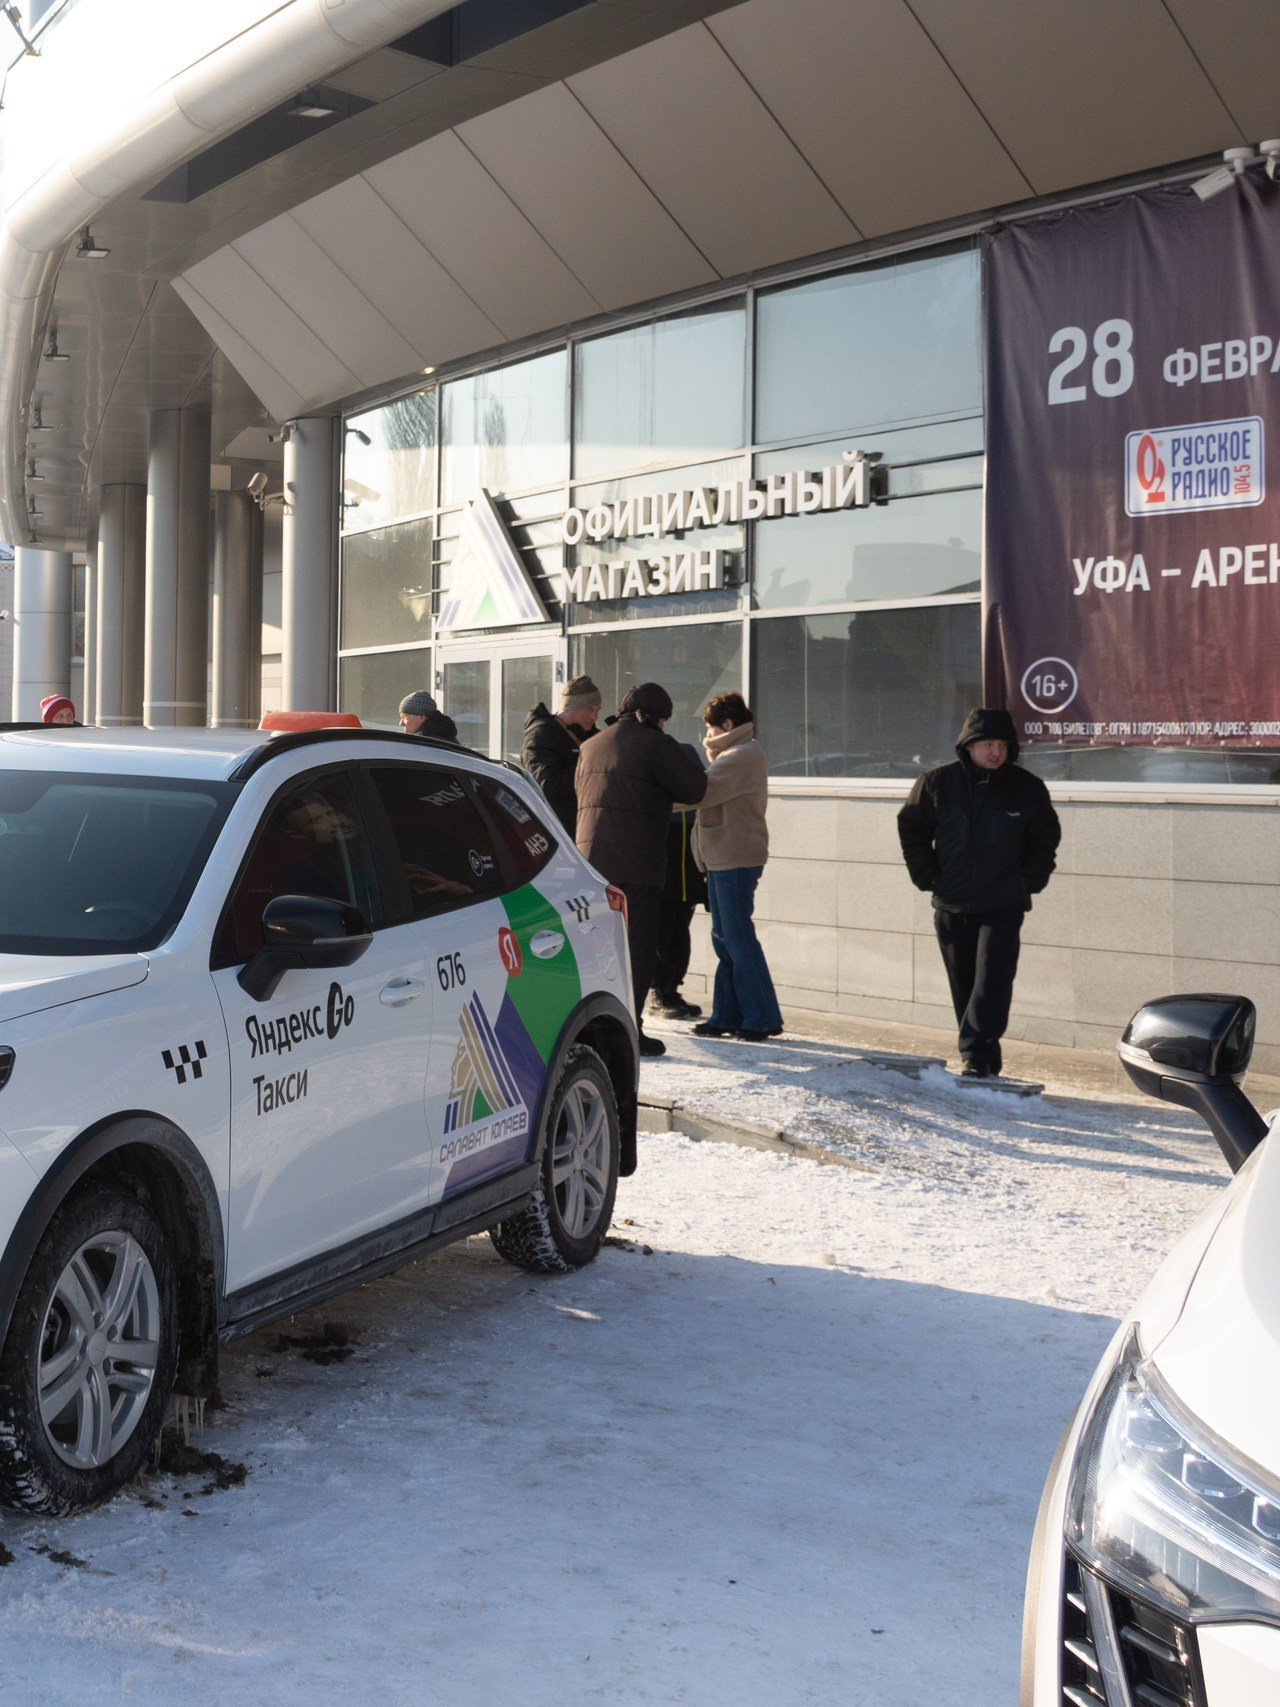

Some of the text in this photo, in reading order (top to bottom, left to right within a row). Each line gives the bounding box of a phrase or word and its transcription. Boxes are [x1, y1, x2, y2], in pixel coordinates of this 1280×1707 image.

[1048, 318, 1134, 405] 28
[1171, 429, 1251, 468] РУССКОЕ
[561, 450, 873, 546] ОФИЦИАЛЬНЫЙ
[1172, 467, 1230, 501] РАДИО
[560, 547, 725, 603] МАГАЗИН
[1073, 553, 1150, 596] УФА
[1031, 674, 1069, 697] 16+
[1025, 722, 1043, 735] ООО
[437, 952, 466, 991] 676
[245, 981, 355, 1059] Яндекс Go
[252, 1069, 308, 1117] Такси
[440, 1111, 528, 1164] САЛАВАТ ЮЛАЕВ
